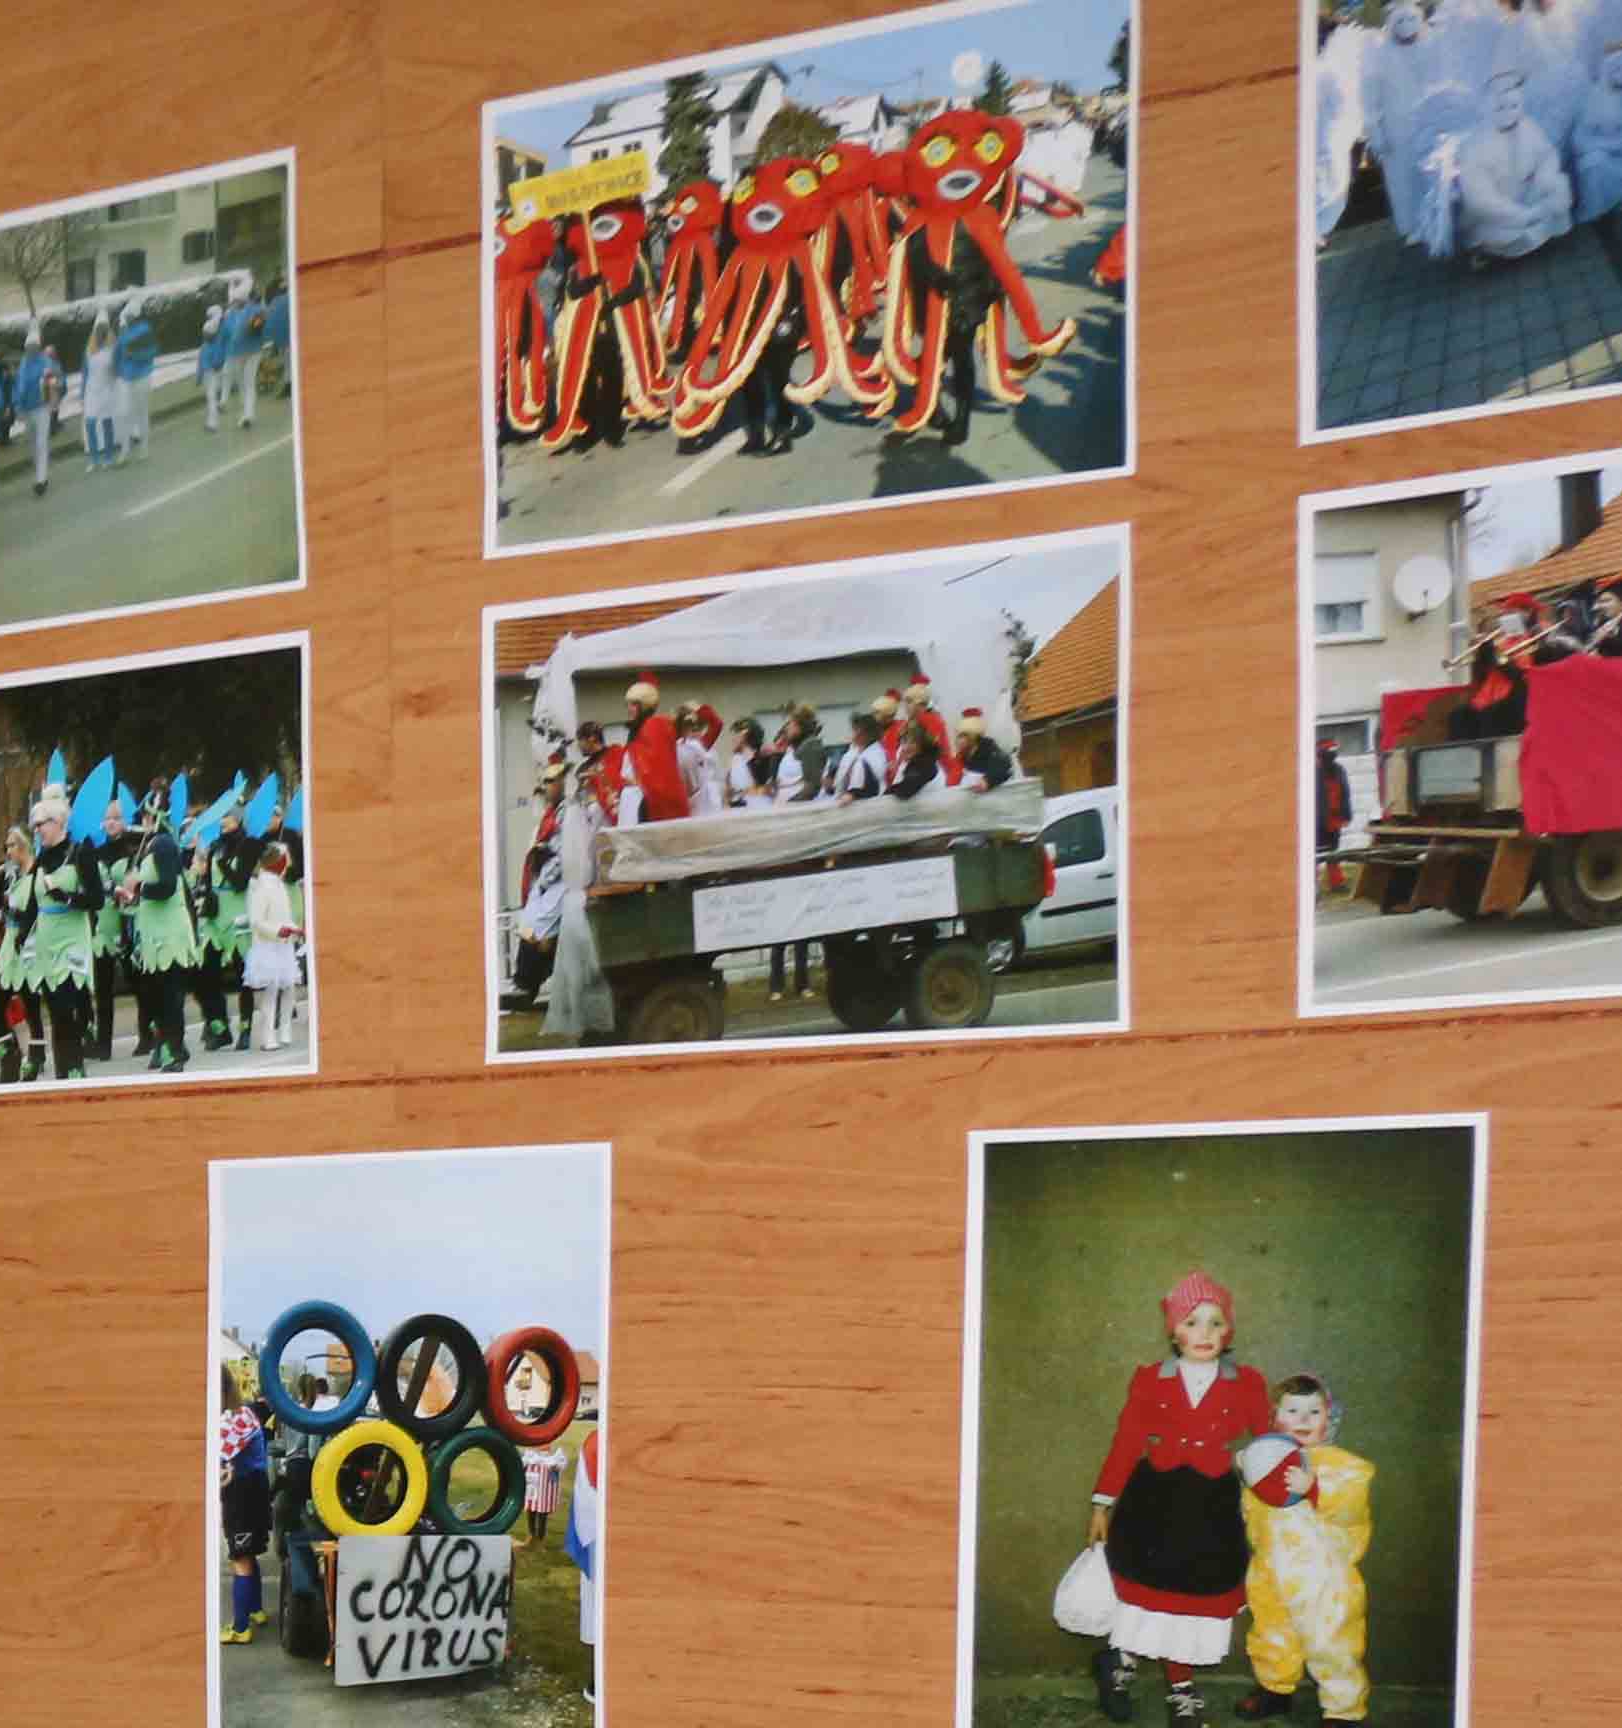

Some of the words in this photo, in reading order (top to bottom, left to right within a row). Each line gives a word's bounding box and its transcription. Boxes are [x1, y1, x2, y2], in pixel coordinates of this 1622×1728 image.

[399, 1535, 481, 1584] NO
[349, 1573, 511, 1622] CORONA
[357, 1628, 504, 1679] VIRUS
